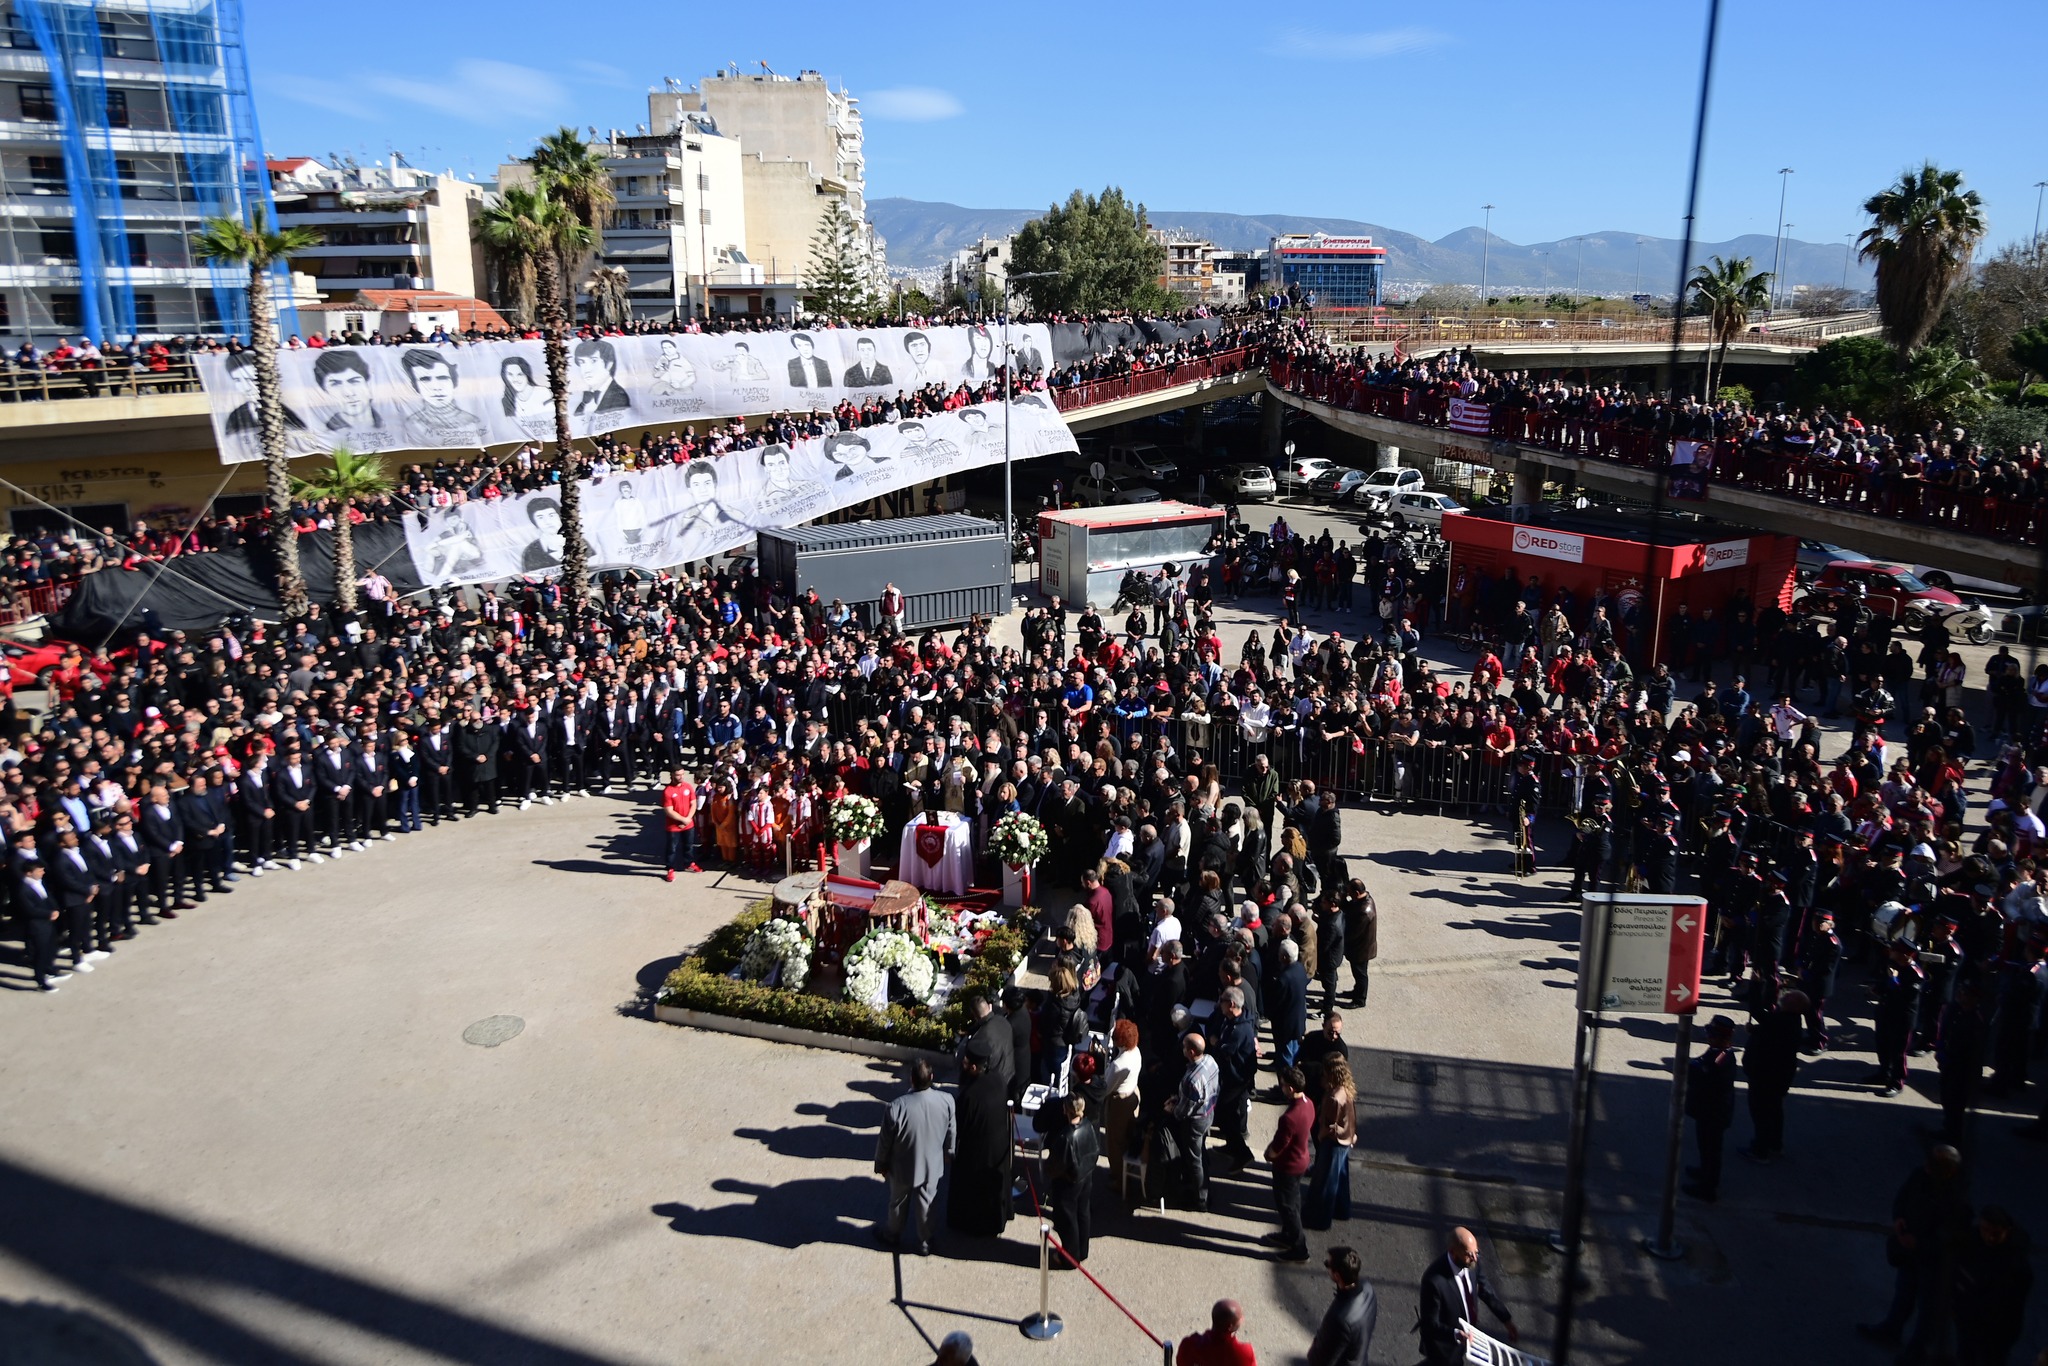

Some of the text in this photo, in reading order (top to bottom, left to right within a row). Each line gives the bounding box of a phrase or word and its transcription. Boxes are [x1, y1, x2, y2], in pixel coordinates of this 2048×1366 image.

[1443, 445, 1491, 465] PARKING
[1531, 537, 1582, 553] RED store
[1716, 549, 1733, 561] RED
[1614, 907, 1668, 915] Οδός Πειραιώς
[1629, 985, 1662, 993] Φαλήρου
